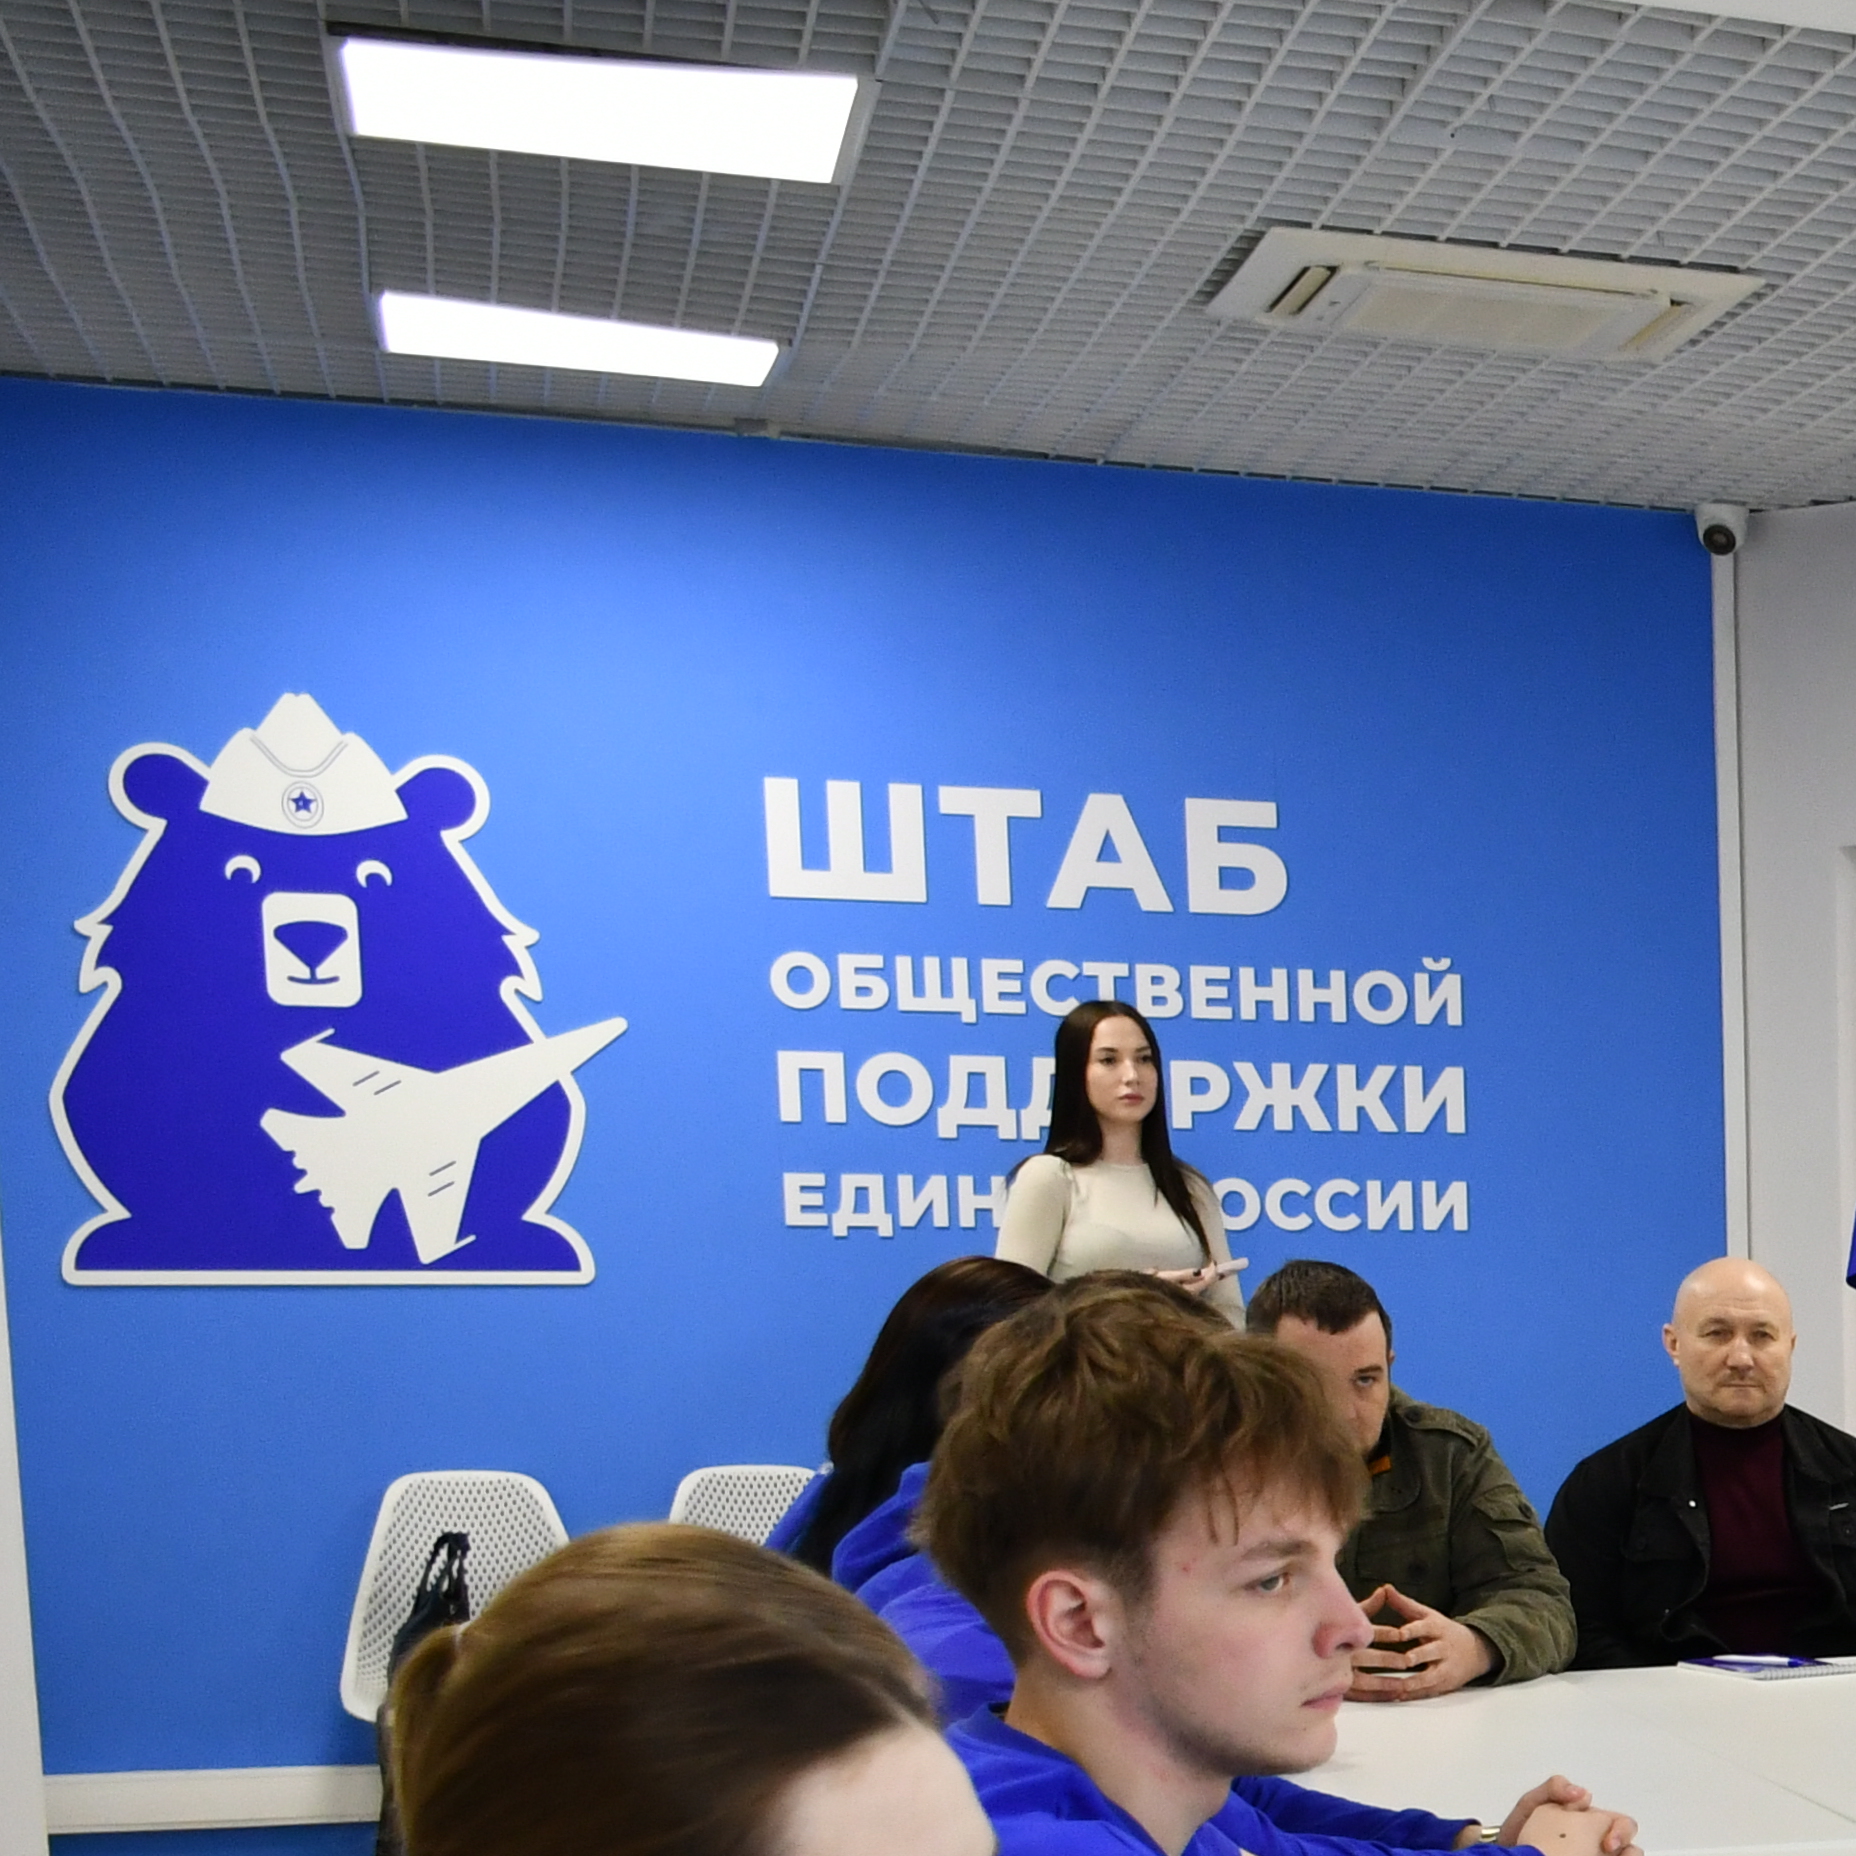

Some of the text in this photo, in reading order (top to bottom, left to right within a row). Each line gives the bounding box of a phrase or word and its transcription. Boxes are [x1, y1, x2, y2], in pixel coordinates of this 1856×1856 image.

[763, 776, 1289, 917] ШТАБ
[769, 951, 1464, 1027] ОБЩЕСТВЕННОЙ
[776, 1050, 1468, 1140] ПОДРЖКИ
[783, 1172, 1469, 1238] ЕДИН ОССИИ
